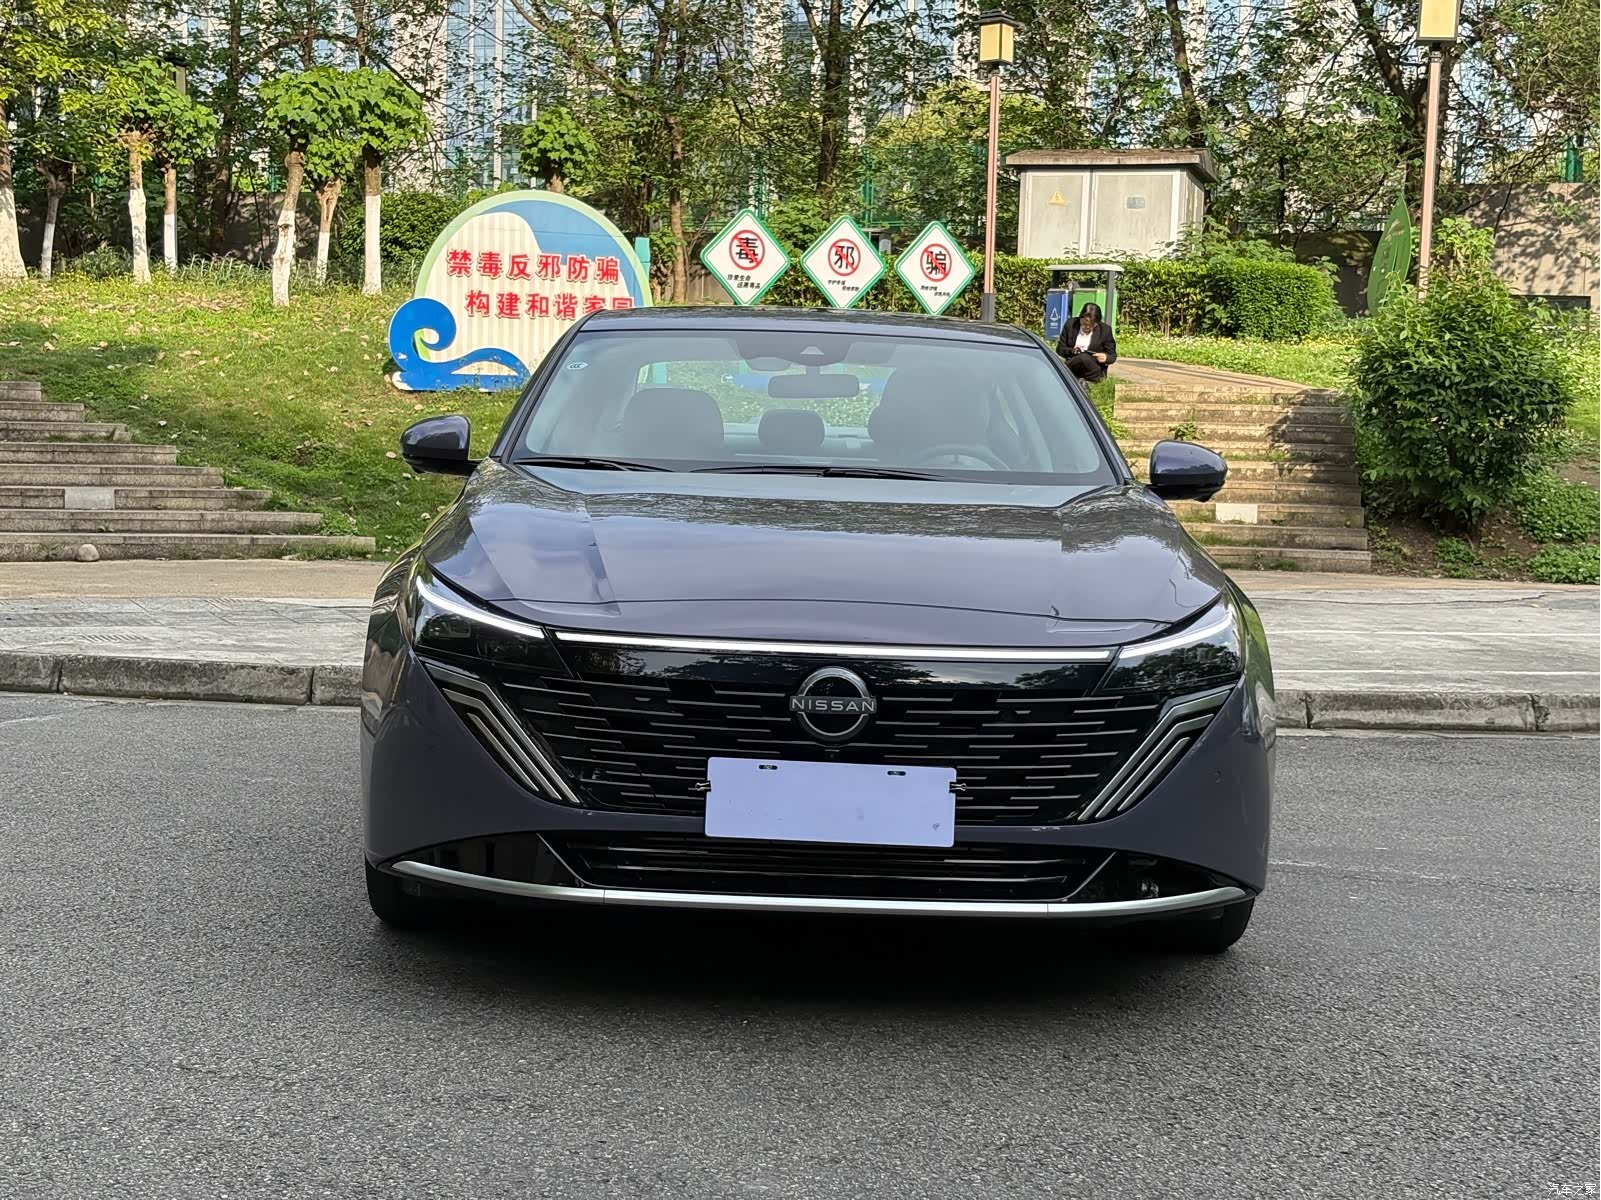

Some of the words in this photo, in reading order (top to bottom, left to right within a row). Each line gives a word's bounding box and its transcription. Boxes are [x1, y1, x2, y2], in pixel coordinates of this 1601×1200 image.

[447, 249, 620, 284] 禁毒反邪防骗
[792, 699, 875, 711] NISSAN
